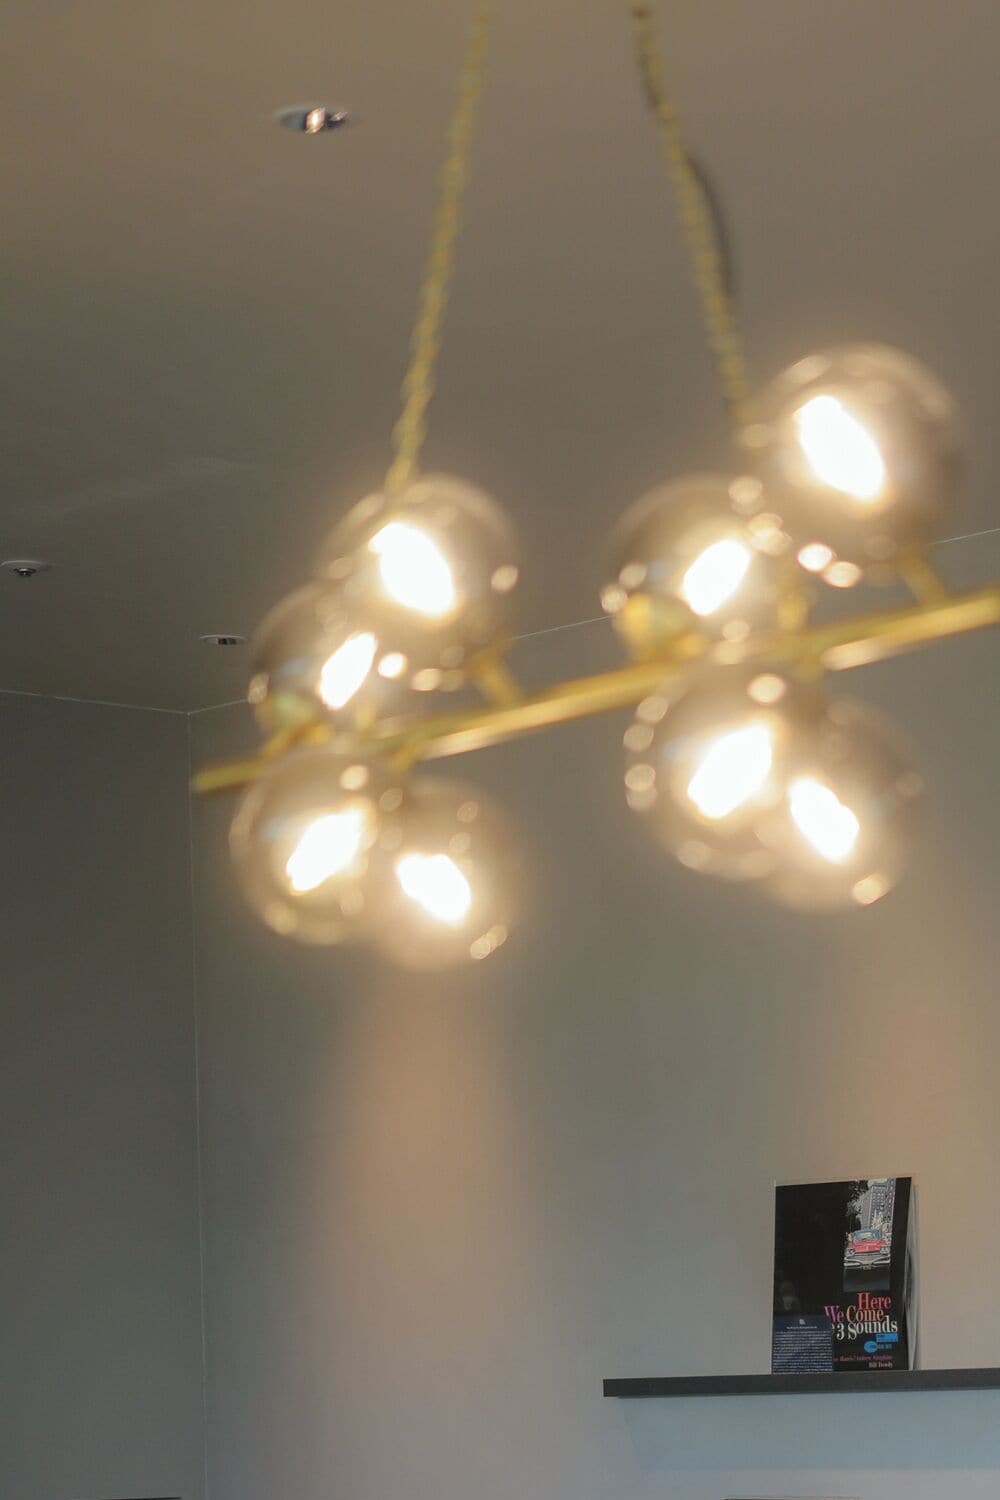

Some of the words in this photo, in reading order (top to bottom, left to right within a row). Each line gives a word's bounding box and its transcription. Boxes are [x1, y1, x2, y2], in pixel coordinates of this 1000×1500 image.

[858, 1293, 892, 1310] Here
[825, 1305, 844, 1322] We
[847, 1305, 884, 1322] Come
[837, 1323, 845, 1340] 3
[848, 1315, 898, 1340] Sounds
